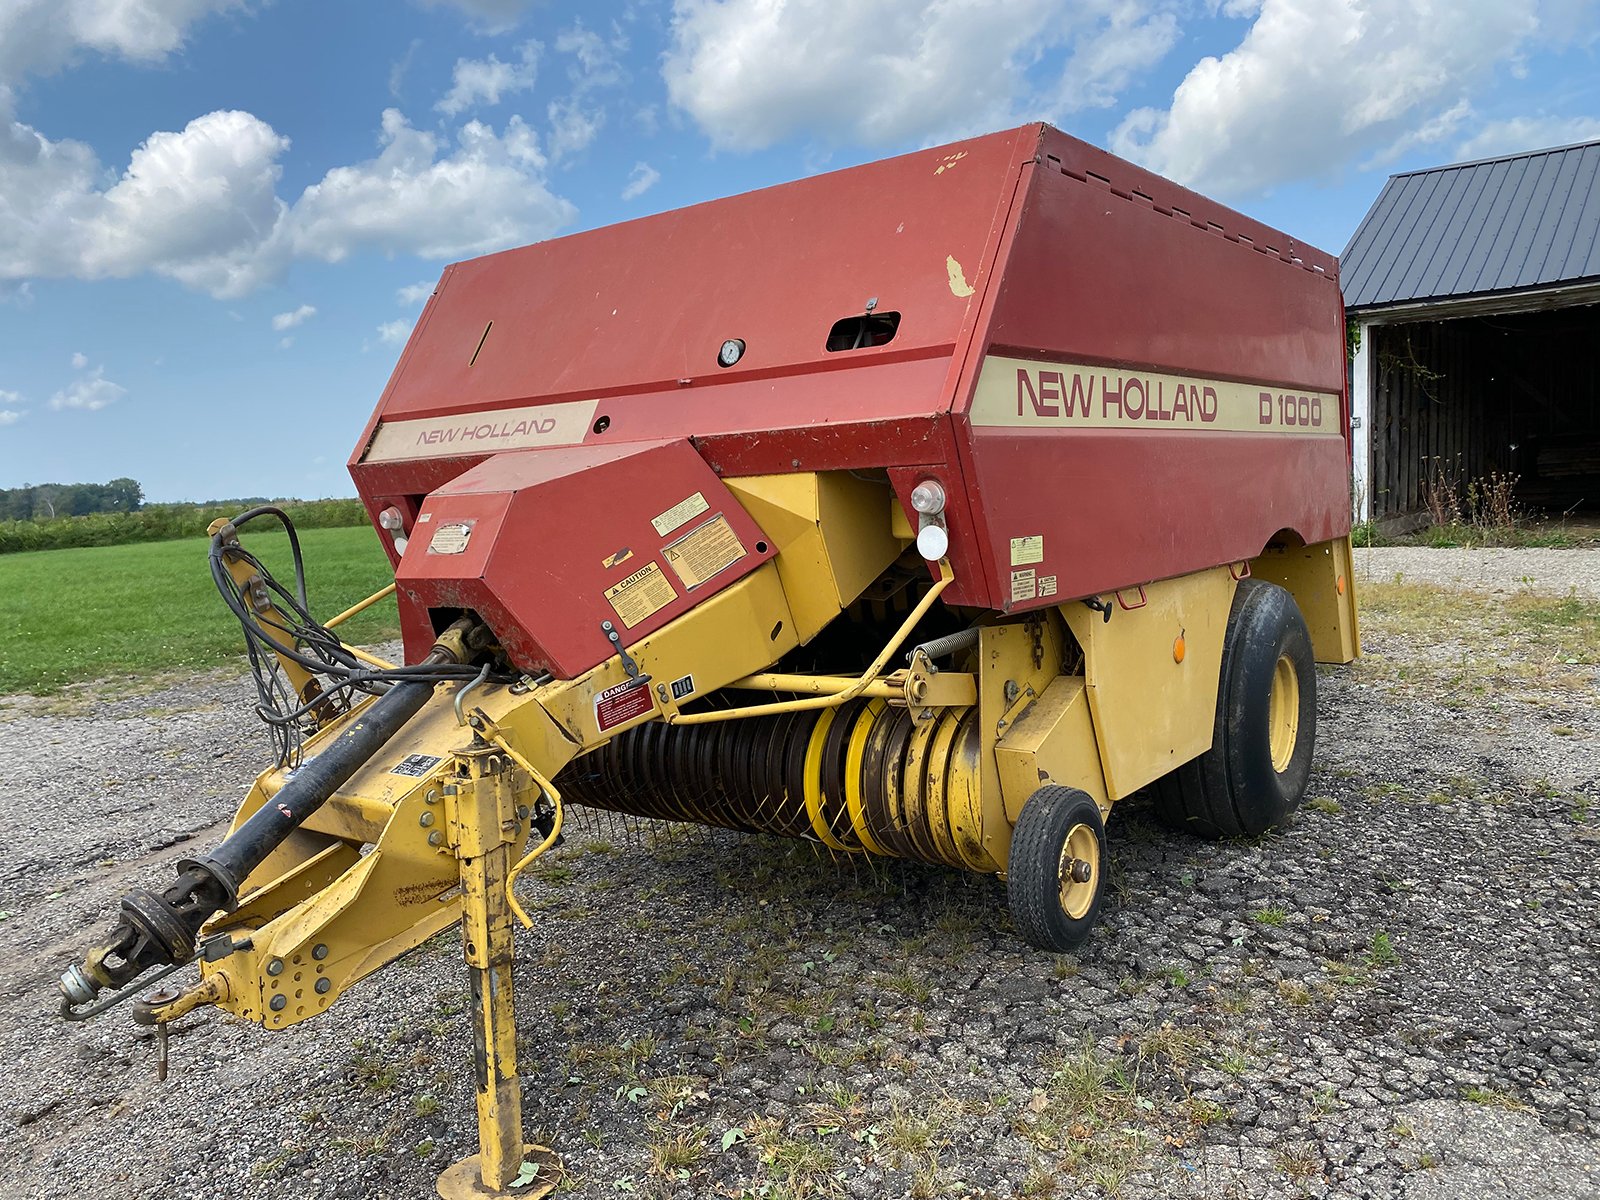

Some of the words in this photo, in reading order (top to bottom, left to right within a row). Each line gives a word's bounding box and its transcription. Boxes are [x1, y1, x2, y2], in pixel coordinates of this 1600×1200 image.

[1017, 369, 1094, 418] NEW
[1102, 376, 1217, 422] HOLLAND
[1259, 392, 1272, 425] D
[1278, 394, 1322, 426] 1000
[416, 427, 460, 445] NEW
[461, 418, 556, 441] HOLLAND
[620, 566, 652, 588] CAUTION
